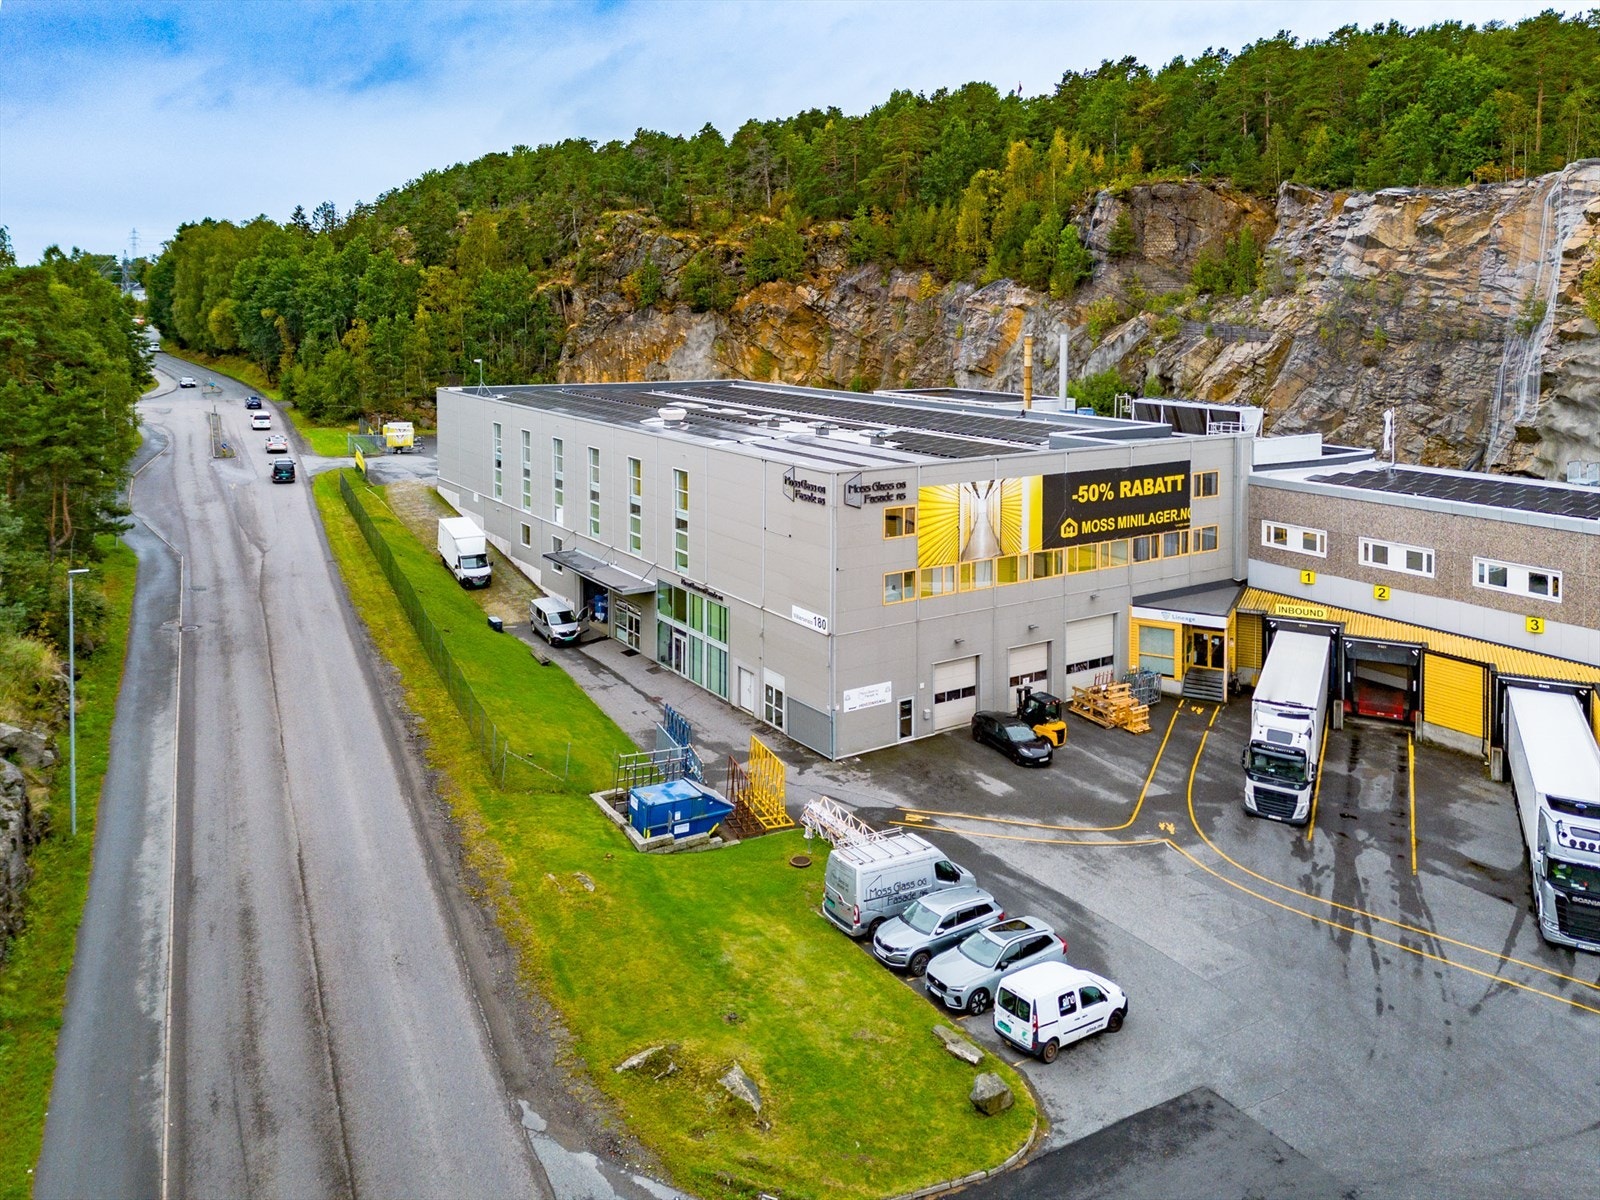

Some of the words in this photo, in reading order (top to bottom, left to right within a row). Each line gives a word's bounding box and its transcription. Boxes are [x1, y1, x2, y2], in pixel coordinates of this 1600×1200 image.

[848, 484, 871, 494] Moss
[871, 481, 895, 492] Glass
[1072, 483, 1115, 503] -50%
[1120, 474, 1185, 498] RABATT
[1081, 517, 1116, 534] MOSS
[1305, 572, 1311, 582] 1
[1378, 587, 1386, 598] 2
[1278, 605, 1324, 618] INBOUND
[813, 616, 827, 630] 180
[1530, 619, 1539, 631] 3
[869, 886, 892, 899] Moss
[893, 880, 916, 893] Glass
